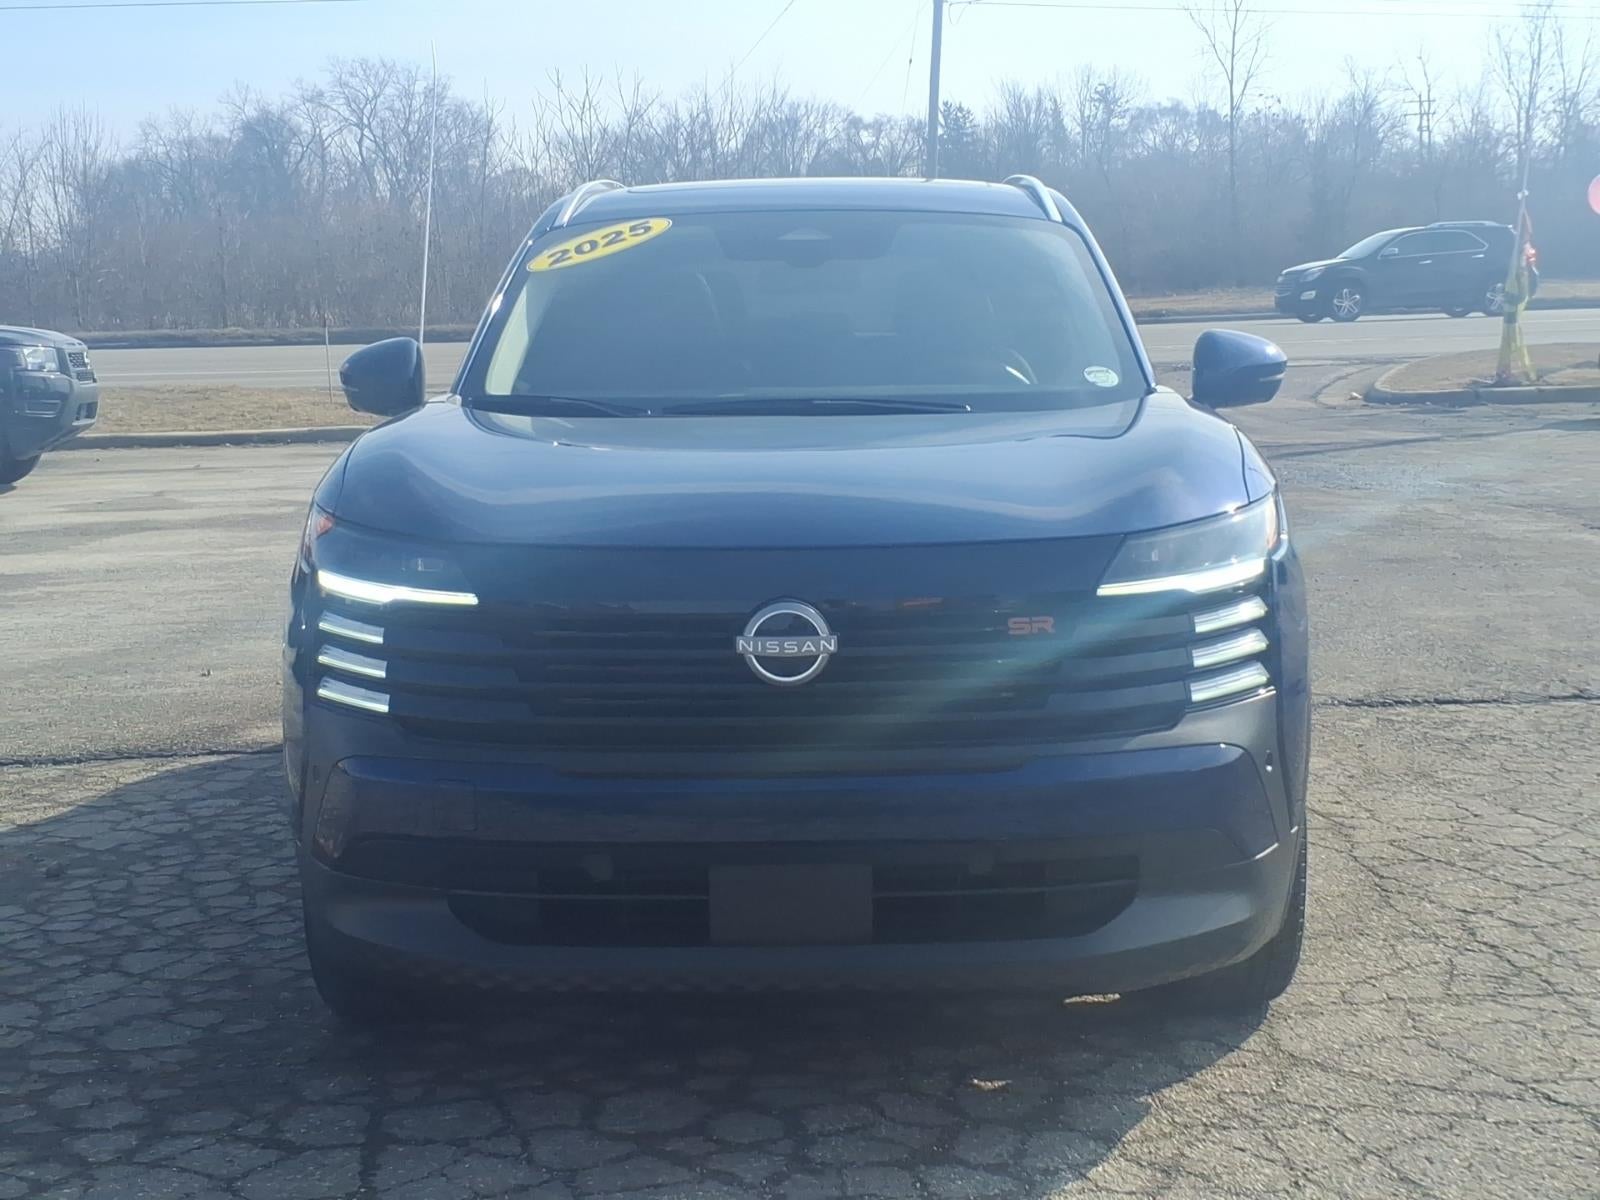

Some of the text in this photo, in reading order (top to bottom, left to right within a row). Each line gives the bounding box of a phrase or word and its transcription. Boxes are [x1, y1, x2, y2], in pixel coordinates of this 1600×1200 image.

[547, 220, 652, 267] 2025
[1007, 616, 1055, 635] SR
[738, 637, 836, 654] NISSAN
